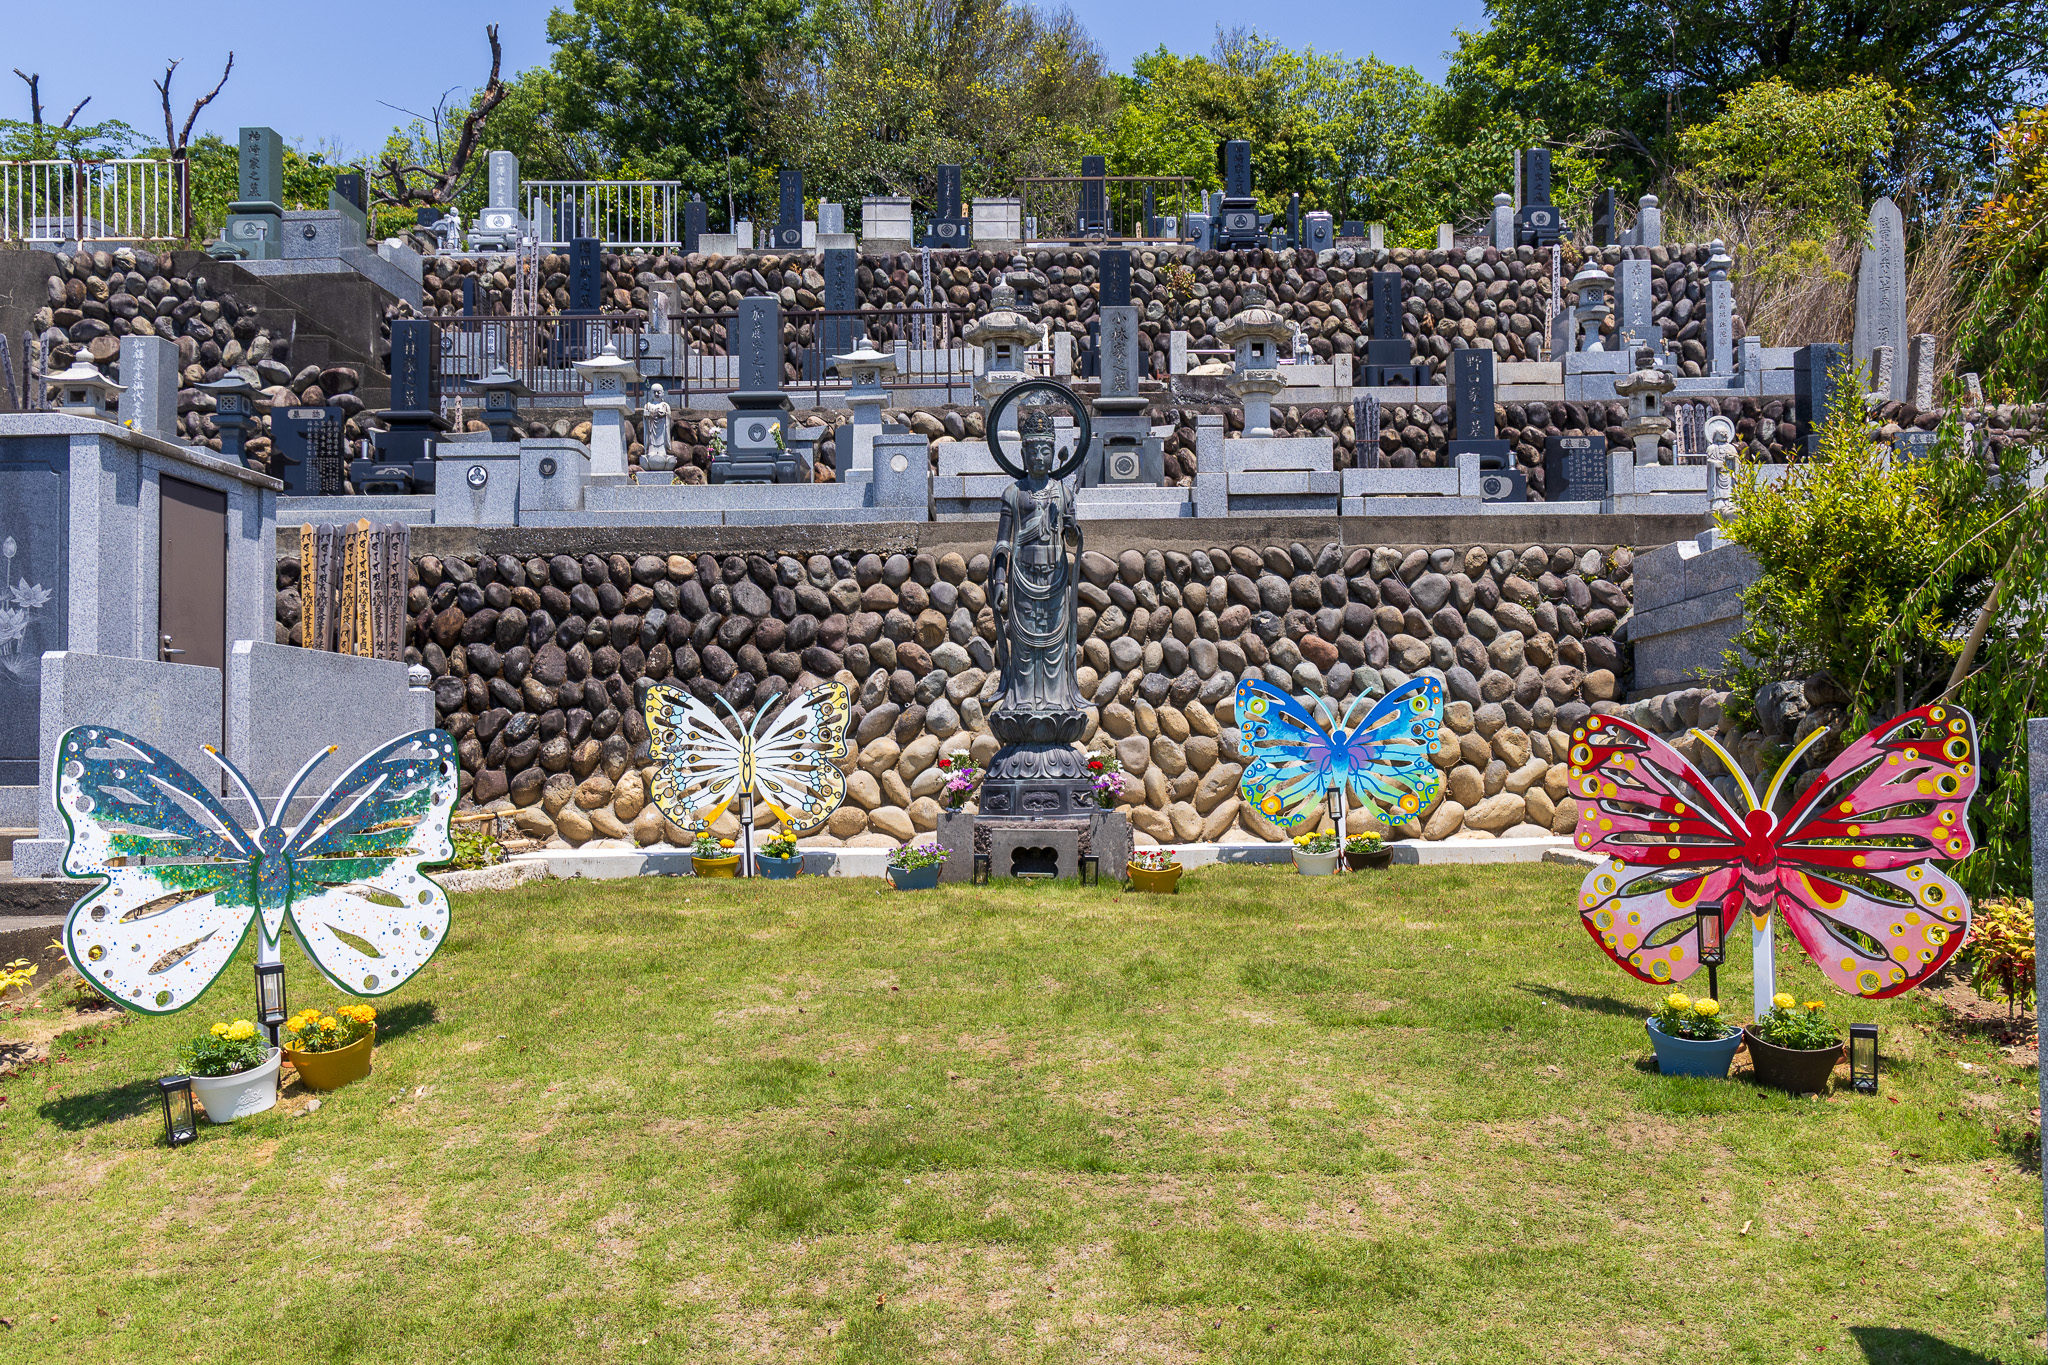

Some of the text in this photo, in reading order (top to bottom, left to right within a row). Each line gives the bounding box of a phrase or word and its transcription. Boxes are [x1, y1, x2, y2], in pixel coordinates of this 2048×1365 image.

[751, 304, 766, 386] 加藤家之墓
[1464, 353, 1486, 437] 野口家之墓
